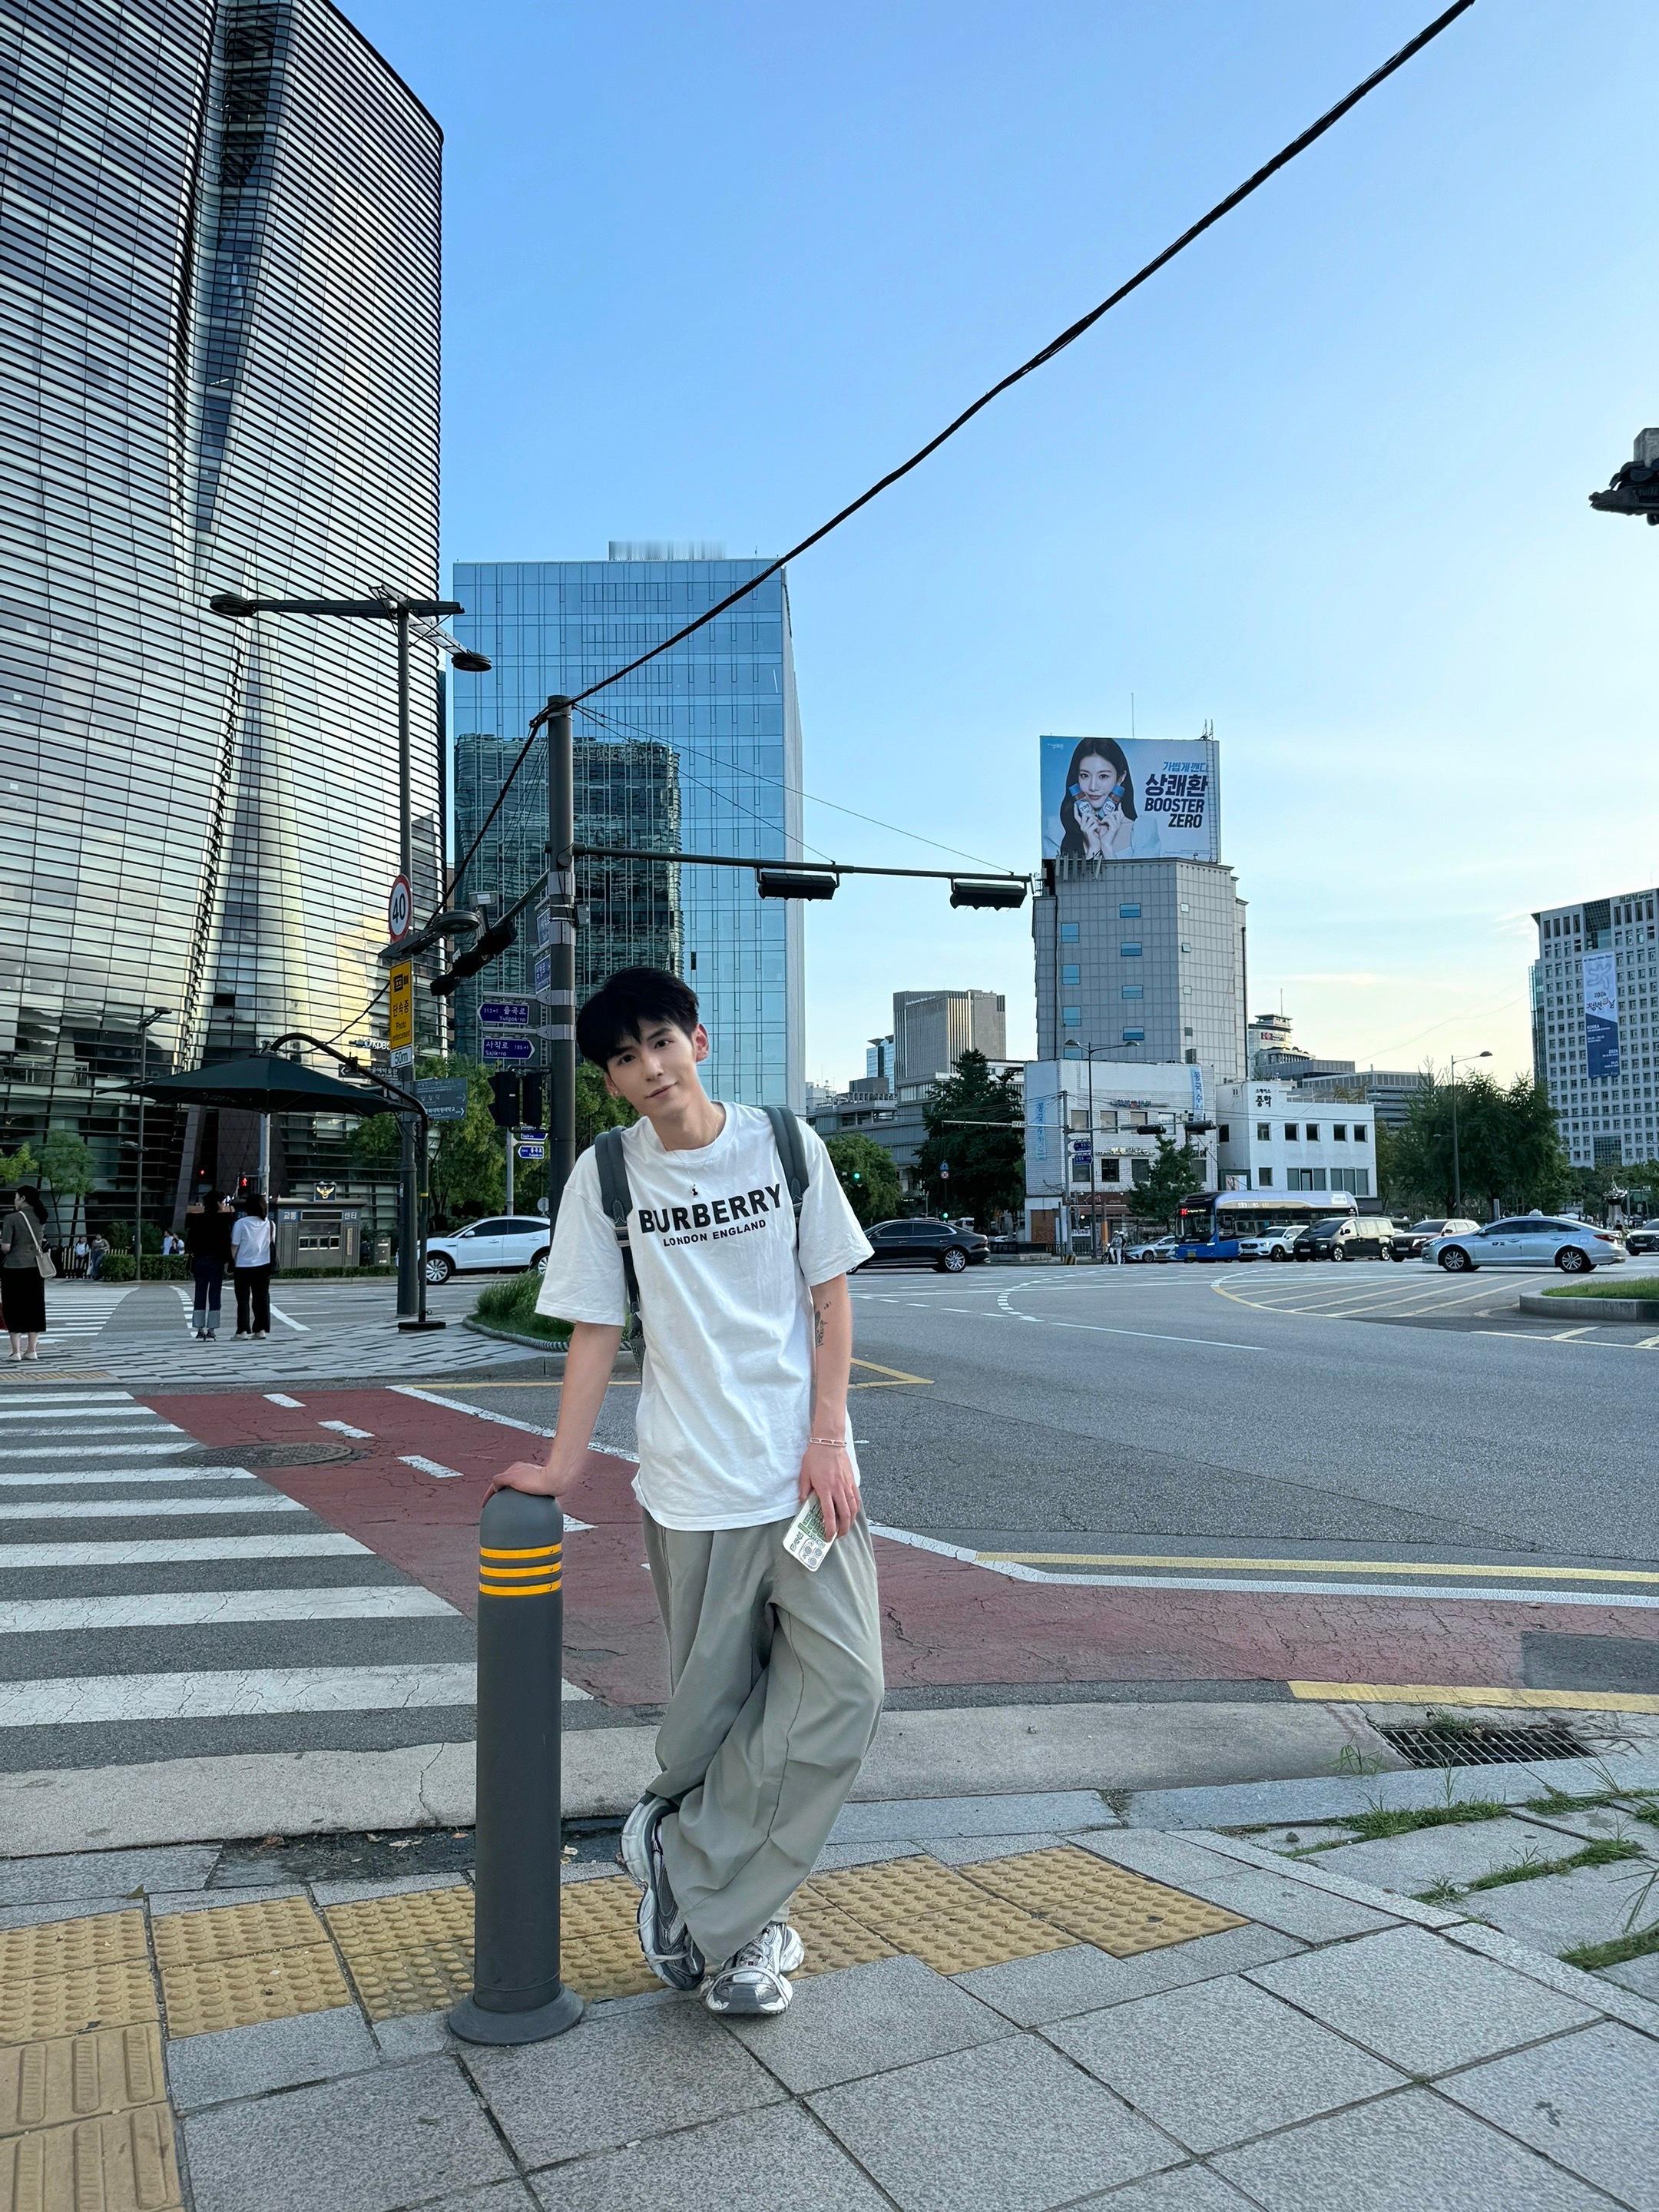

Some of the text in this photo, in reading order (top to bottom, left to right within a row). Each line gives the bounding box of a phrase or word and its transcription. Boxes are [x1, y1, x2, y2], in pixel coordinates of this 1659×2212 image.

[1163, 761, 1190, 773] 가볍게
[1145, 773, 1208, 797] 상쾌환
[1144, 797, 1205, 813] BOOSTER
[1168, 813, 1203, 829] ZERO
[392, 892, 406, 924] 40
[392, 999, 409, 1018] 단속중
[503, 1005, 526, 1015] 율곡로
[485, 1040, 508, 1050] 사직로
[394, 1050, 409, 1065] 50m
[1255, 1095, 1273, 1108] 중학
[283, 1211, 296, 1220] 교통
[344, 1211, 357, 1220] 센터
[638, 1184, 781, 1233] BURBERRY
[663, 1219, 767, 1247] LONDON ENGLAND
